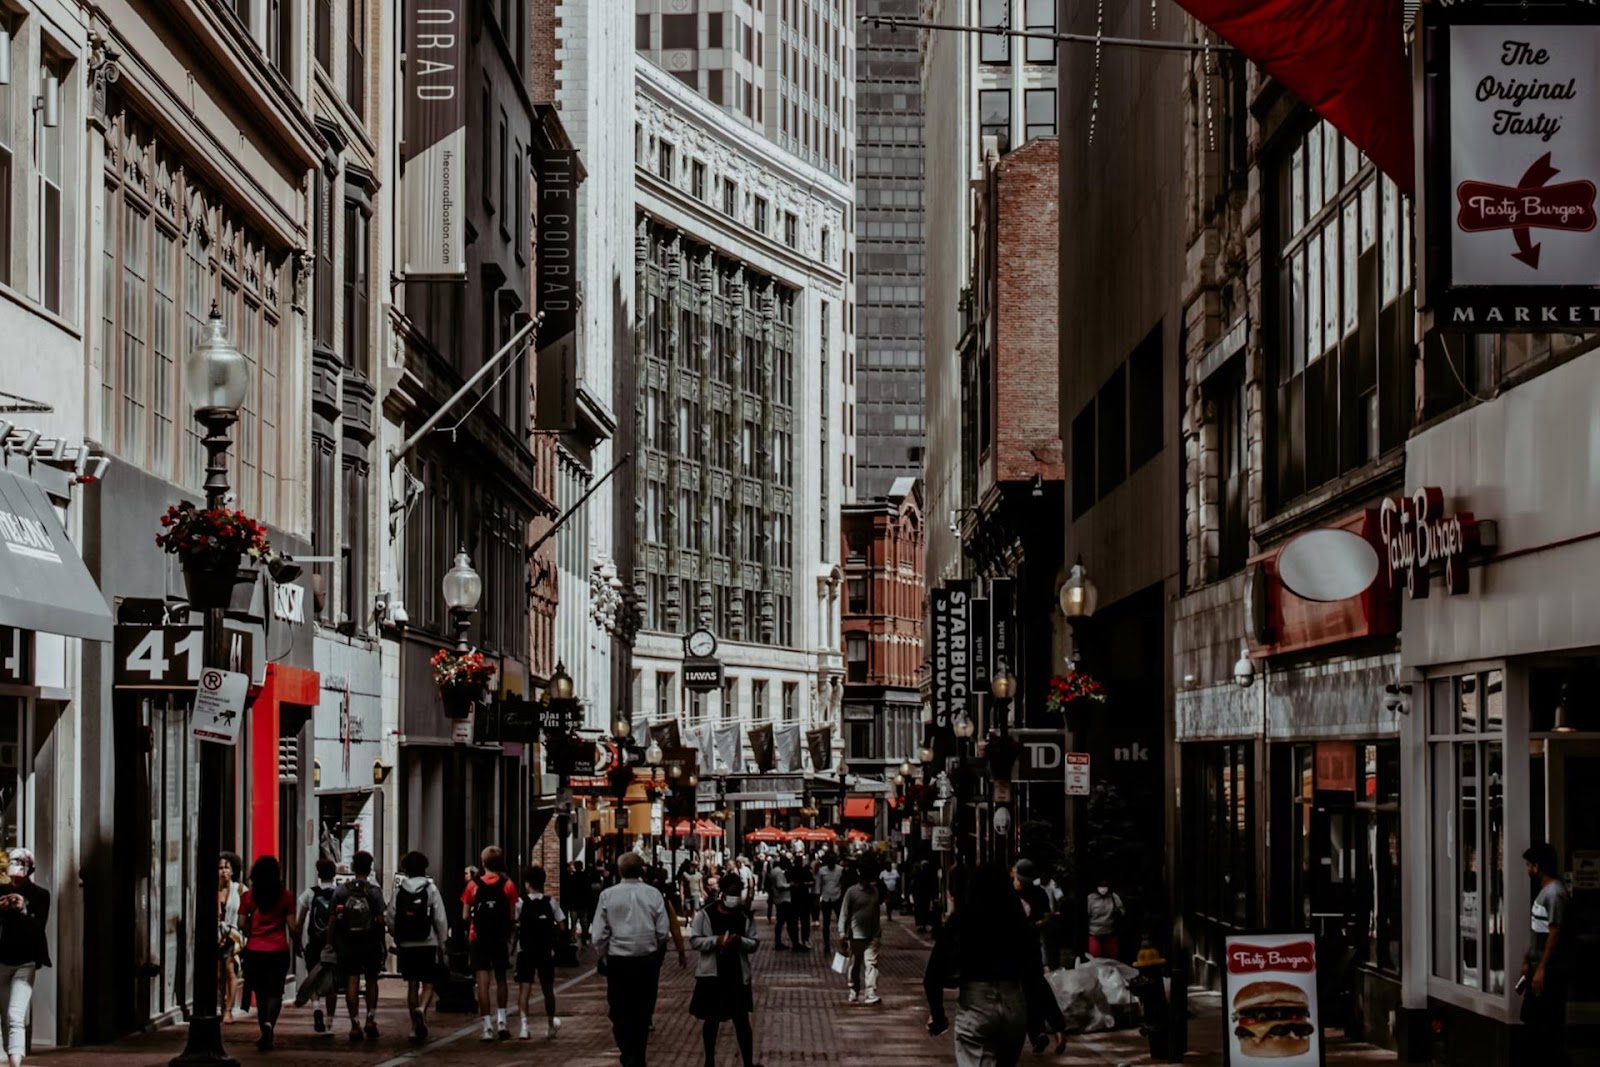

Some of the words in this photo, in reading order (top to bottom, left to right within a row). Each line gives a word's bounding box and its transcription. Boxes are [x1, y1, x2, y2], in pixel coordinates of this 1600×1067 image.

[1501, 40, 1550, 66] The
[1475, 75, 1576, 107] Original
[1492, 110, 1561, 142] Tasty
[543, 155, 570, 200] THE
[441, 150, 453, 265] theconradboston.com
[1468, 195, 1521, 223] Tasty
[1520, 195, 1585, 223] Burger
[543, 213, 570, 312] CONRAD
[1452, 306, 1600, 322] MARKET
[1380, 496, 1416, 600] Tasty
[1412, 486, 1464, 596] Burger
[975, 635, 984, 662] Bank
[996, 620, 1006, 650] Bank
[126, 629, 204, 682] 41
[949, 590, 967, 724] STARBUCKS
[685, 671, 717, 681] HAVAS
[1022, 742, 1062, 769] TD
[1232, 951, 1267, 969] Tasty
[1265, 950, 1310, 969] Burger
